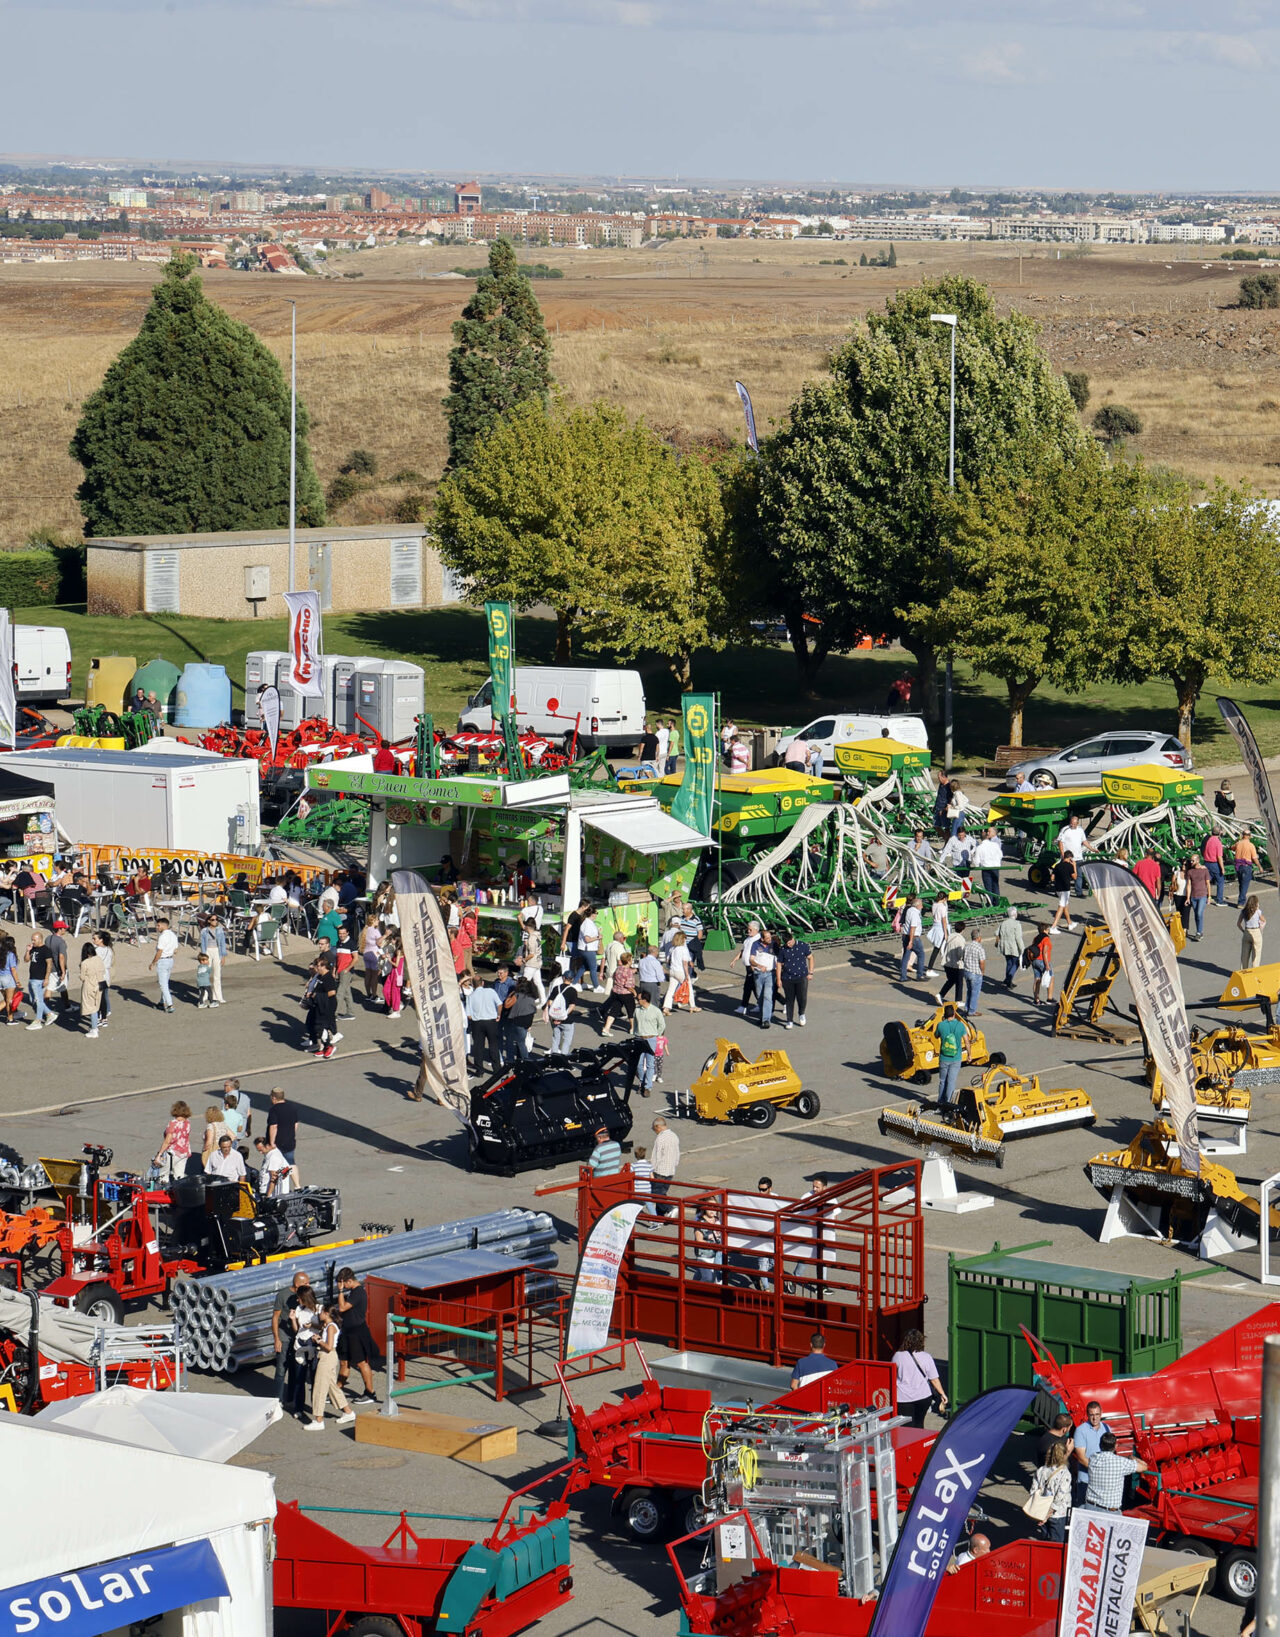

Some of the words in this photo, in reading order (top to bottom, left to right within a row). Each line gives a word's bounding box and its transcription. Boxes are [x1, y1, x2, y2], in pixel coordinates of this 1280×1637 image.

[371, 775, 409, 794] Buen
[413, 780, 461, 799] Comer
[794, 797, 810, 806] GIL
[928, 1527, 950, 1581] solar
[9, 1563, 154, 1633] solar
